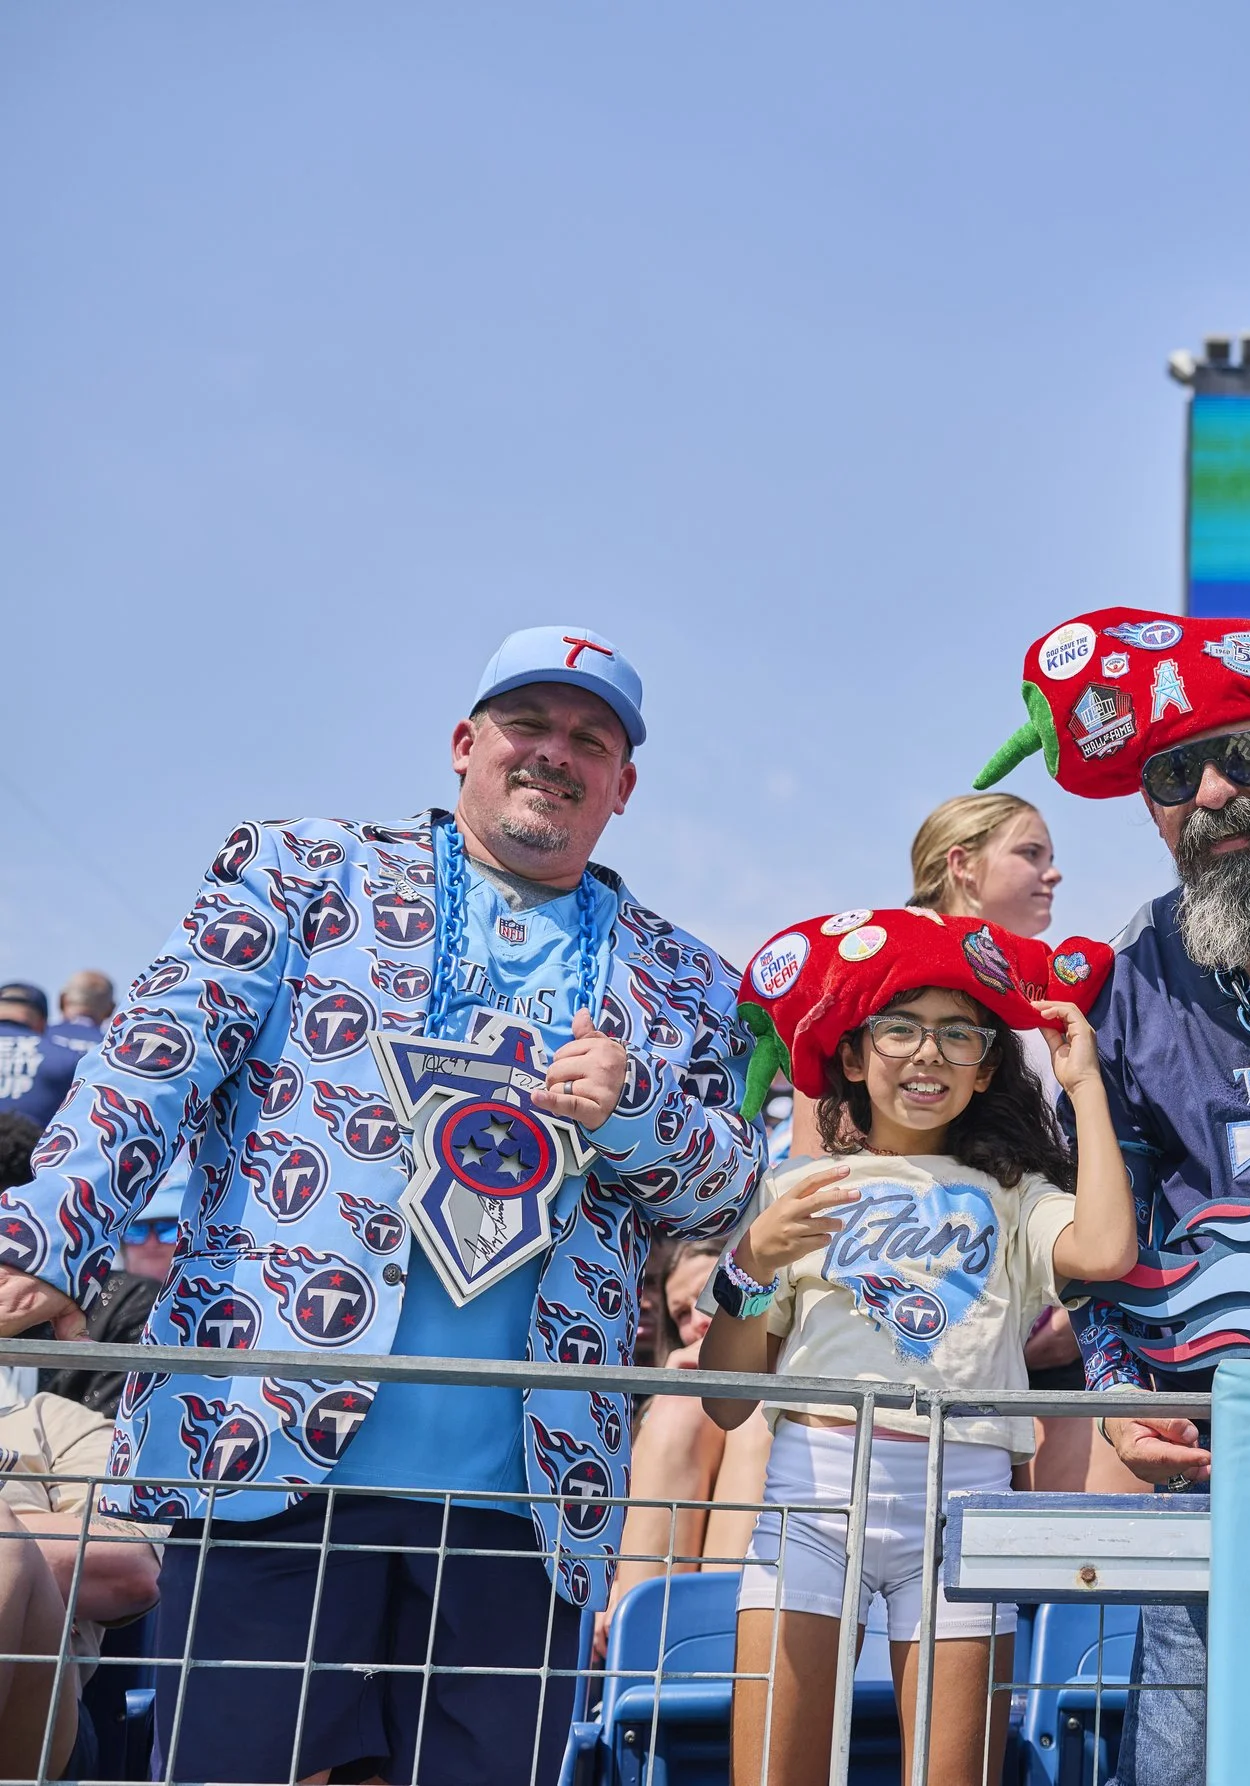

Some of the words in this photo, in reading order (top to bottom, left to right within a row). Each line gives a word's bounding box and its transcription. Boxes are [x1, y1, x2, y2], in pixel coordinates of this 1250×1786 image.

[562, 635, 614, 668] T
[1046, 647, 1060, 659] GOD
[1060, 640, 1075, 653] SAVE
[1046, 644, 1089, 671] KING
[1081, 736, 1106, 756] HALL
[1109, 721, 1132, 742] FAME
[501, 926, 523, 942] NFL
[760, 954, 787, 983] FAN
[764, 960, 799, 994] YEAR
[458, 958, 556, 1025] TITANS
[820, 1192, 995, 1281] Titans
